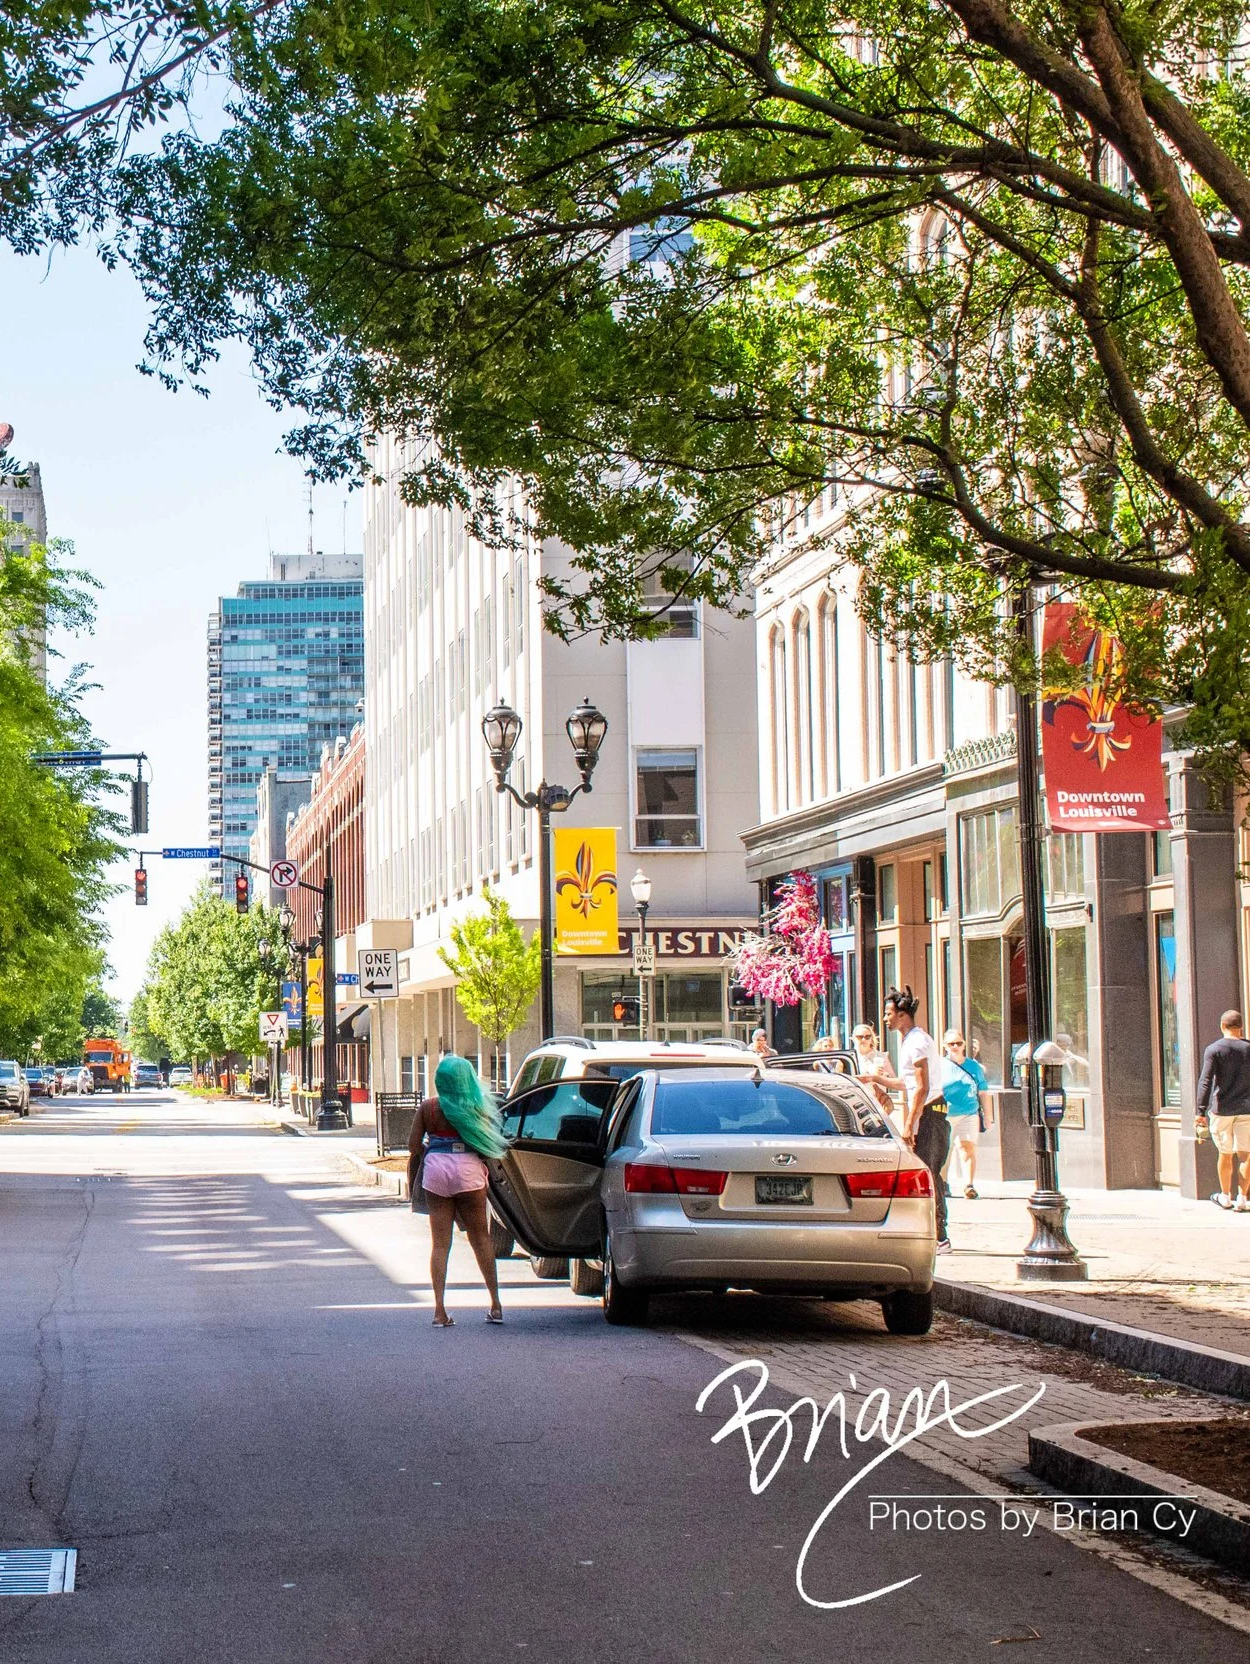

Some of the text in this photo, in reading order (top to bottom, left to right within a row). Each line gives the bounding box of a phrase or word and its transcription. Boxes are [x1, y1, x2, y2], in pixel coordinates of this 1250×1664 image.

[1056, 790, 1146, 803] Downtown
[1058, 804, 1138, 818] Louisville
[176, 849, 210, 858] Chestnut
[561, 930, 608, 938] Downtown
[561, 938, 603, 946] Louisville
[618, 931, 751, 954] HESTN
[636, 947, 653, 956] ONE
[365, 953, 391, 965] ONE
[636, 956, 653, 964] WAY
[365, 966, 392, 978] WAY
